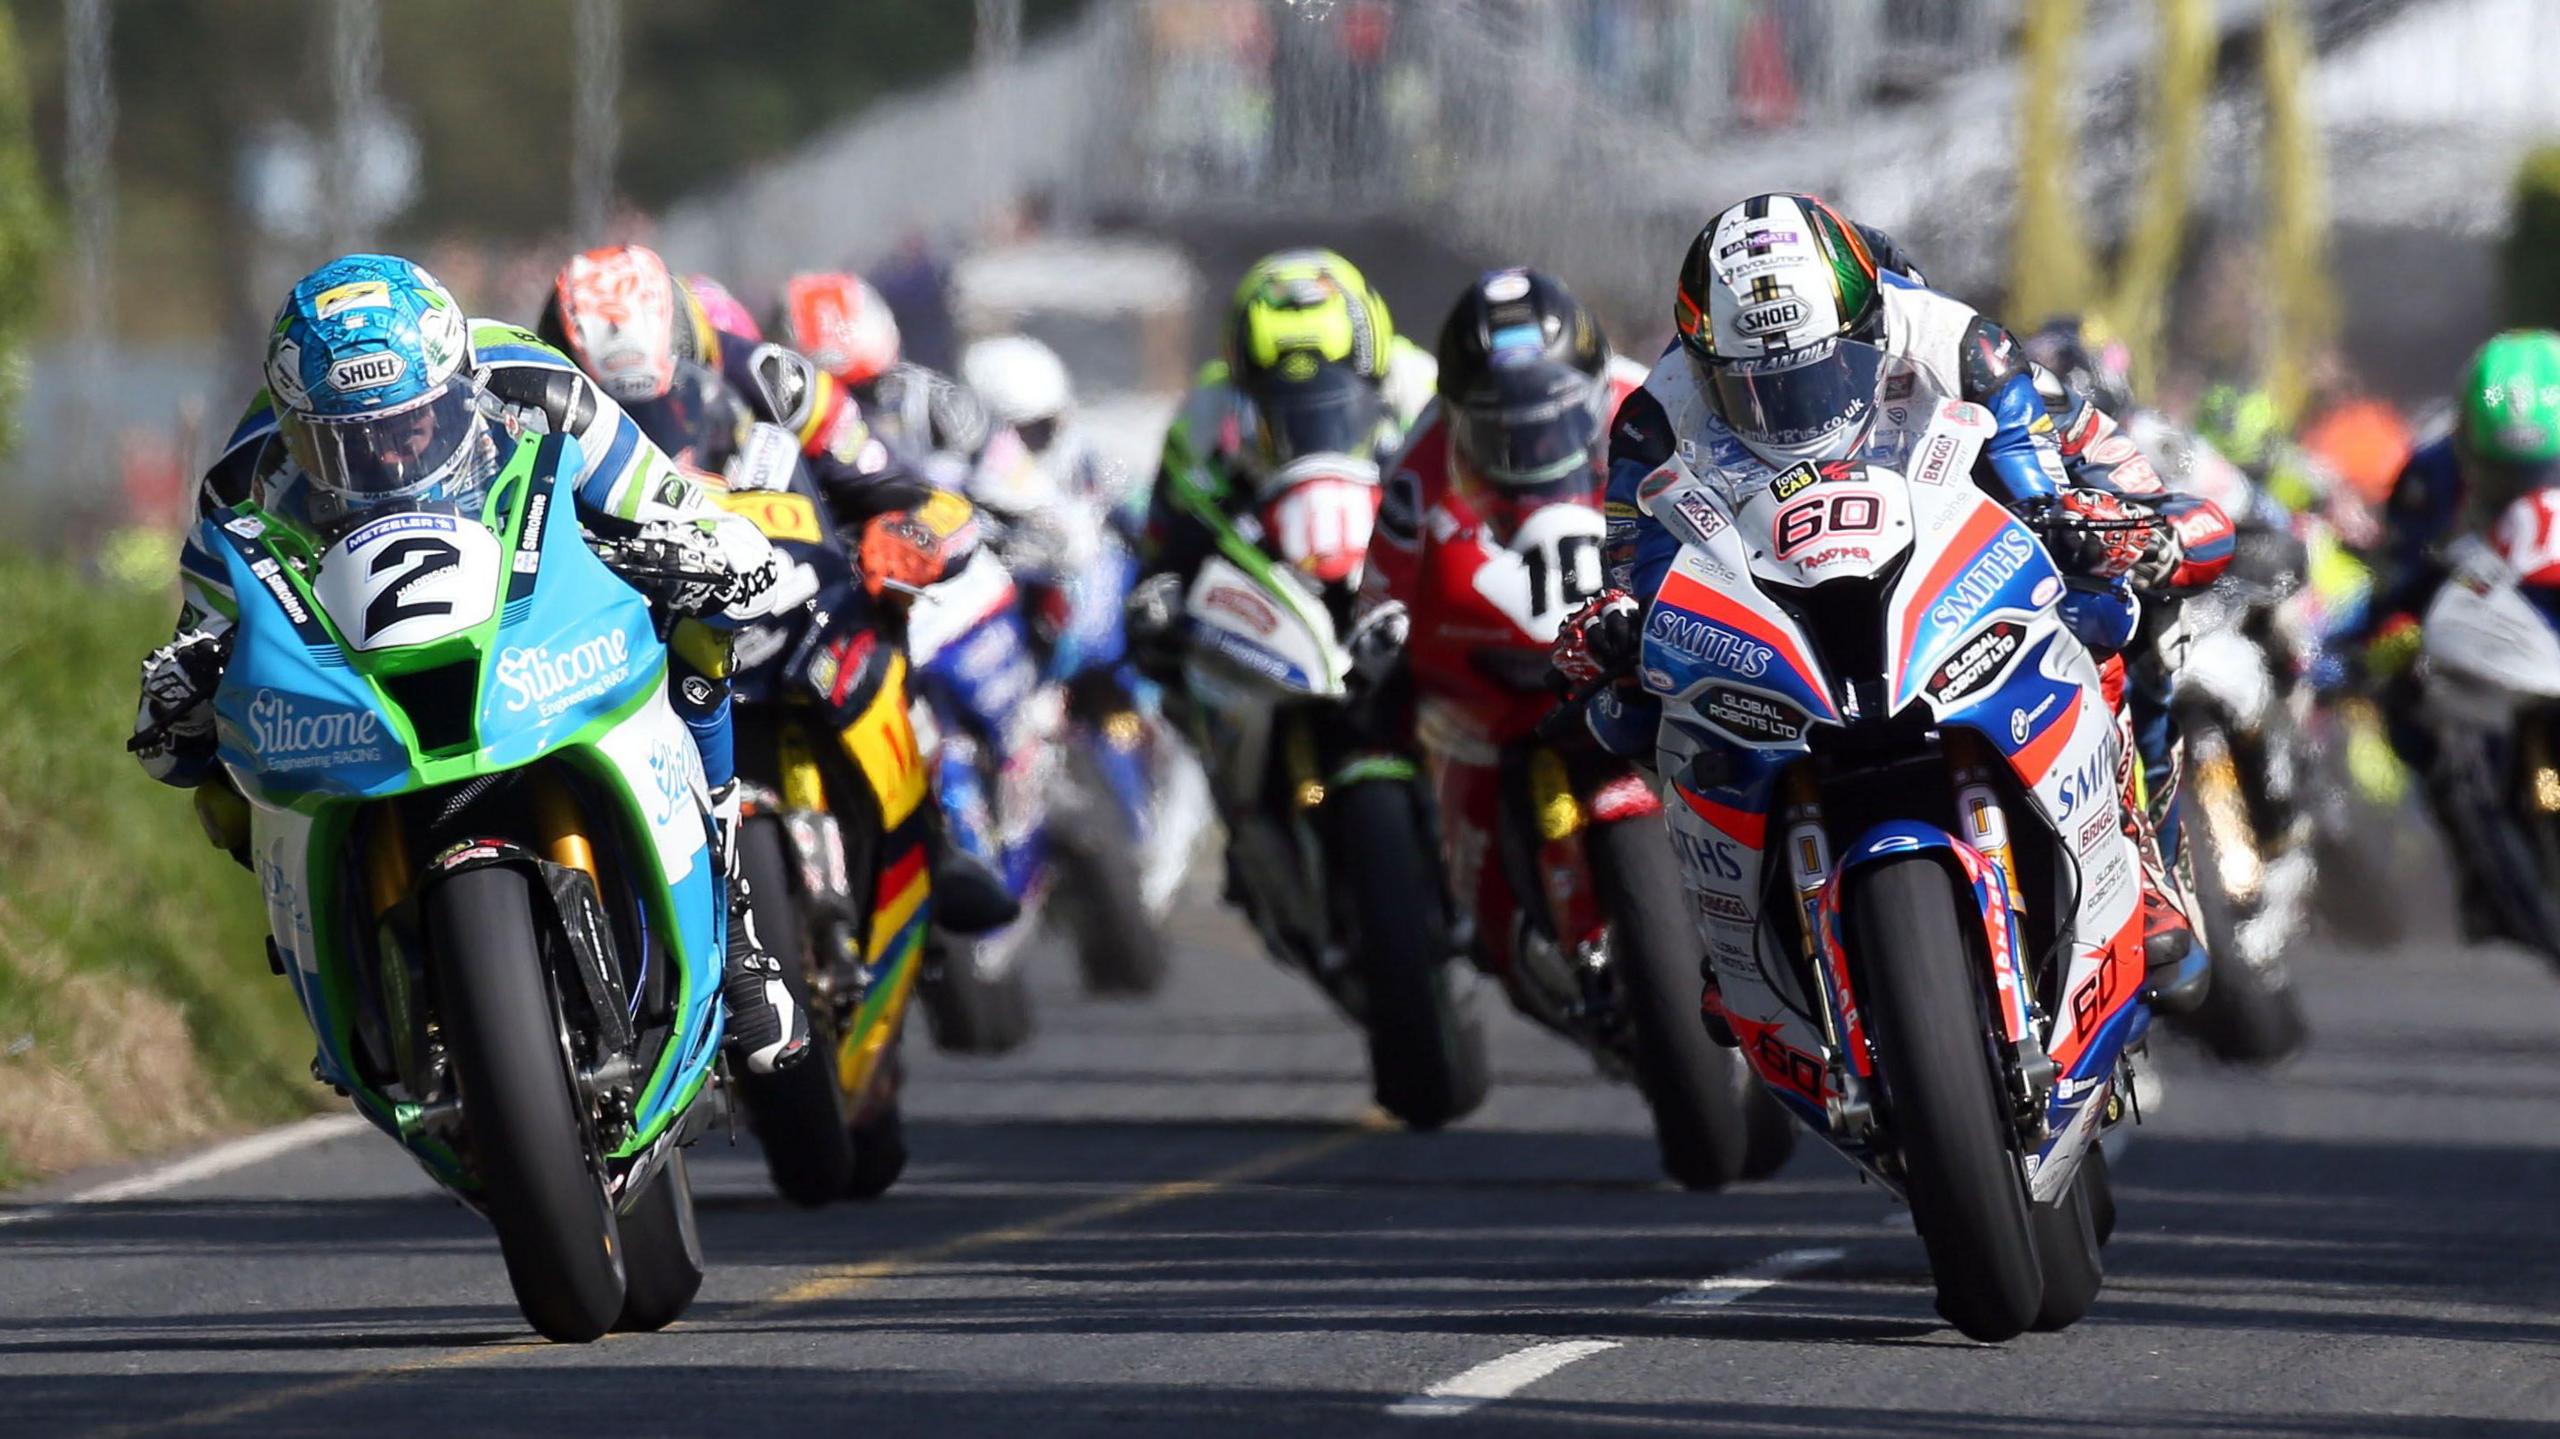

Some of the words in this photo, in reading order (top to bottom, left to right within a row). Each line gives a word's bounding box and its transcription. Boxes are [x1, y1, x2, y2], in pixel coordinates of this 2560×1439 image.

[1725, 232, 1793, 253] BATHGATE
[1736, 256, 1809, 273] EVOLUTION
[1745, 304, 1798, 330] SHOEI
[1799, 336, 1838, 363] OILS
[339, 359, 395, 386] SHOEI
[1780, 473, 1812, 498] CAB
[349, 517, 432, 549] METZELER
[522, 494, 546, 551] Silkolene
[1777, 494, 1880, 556] 60
[266, 573, 309, 625] Silkolene
[364, 537, 461, 644] 2
[396, 564, 460, 599] HARRISON
[1931, 528, 2035, 638] SMITHS
[1651, 610, 1774, 678] SMITHS
[1945, 632, 2000, 681] GLOBAL
[496, 627, 629, 712] Silicone
[1938, 653, 1992, 704] ROBOTS
[1992, 634, 2016, 663] LTD
[539, 680, 601, 718] Engineering
[1722, 693, 1783, 721] GLOBAL
[249, 688, 379, 754] Silicone
[1709, 703, 1768, 733] ROBOTS
[1769, 721, 1798, 740] LTD
[267, 755, 331, 772] Engineering
[333, 747, 381, 766] RACING
[2073, 943, 2117, 1044] 60
[1758, 1030, 1823, 1099] 60
